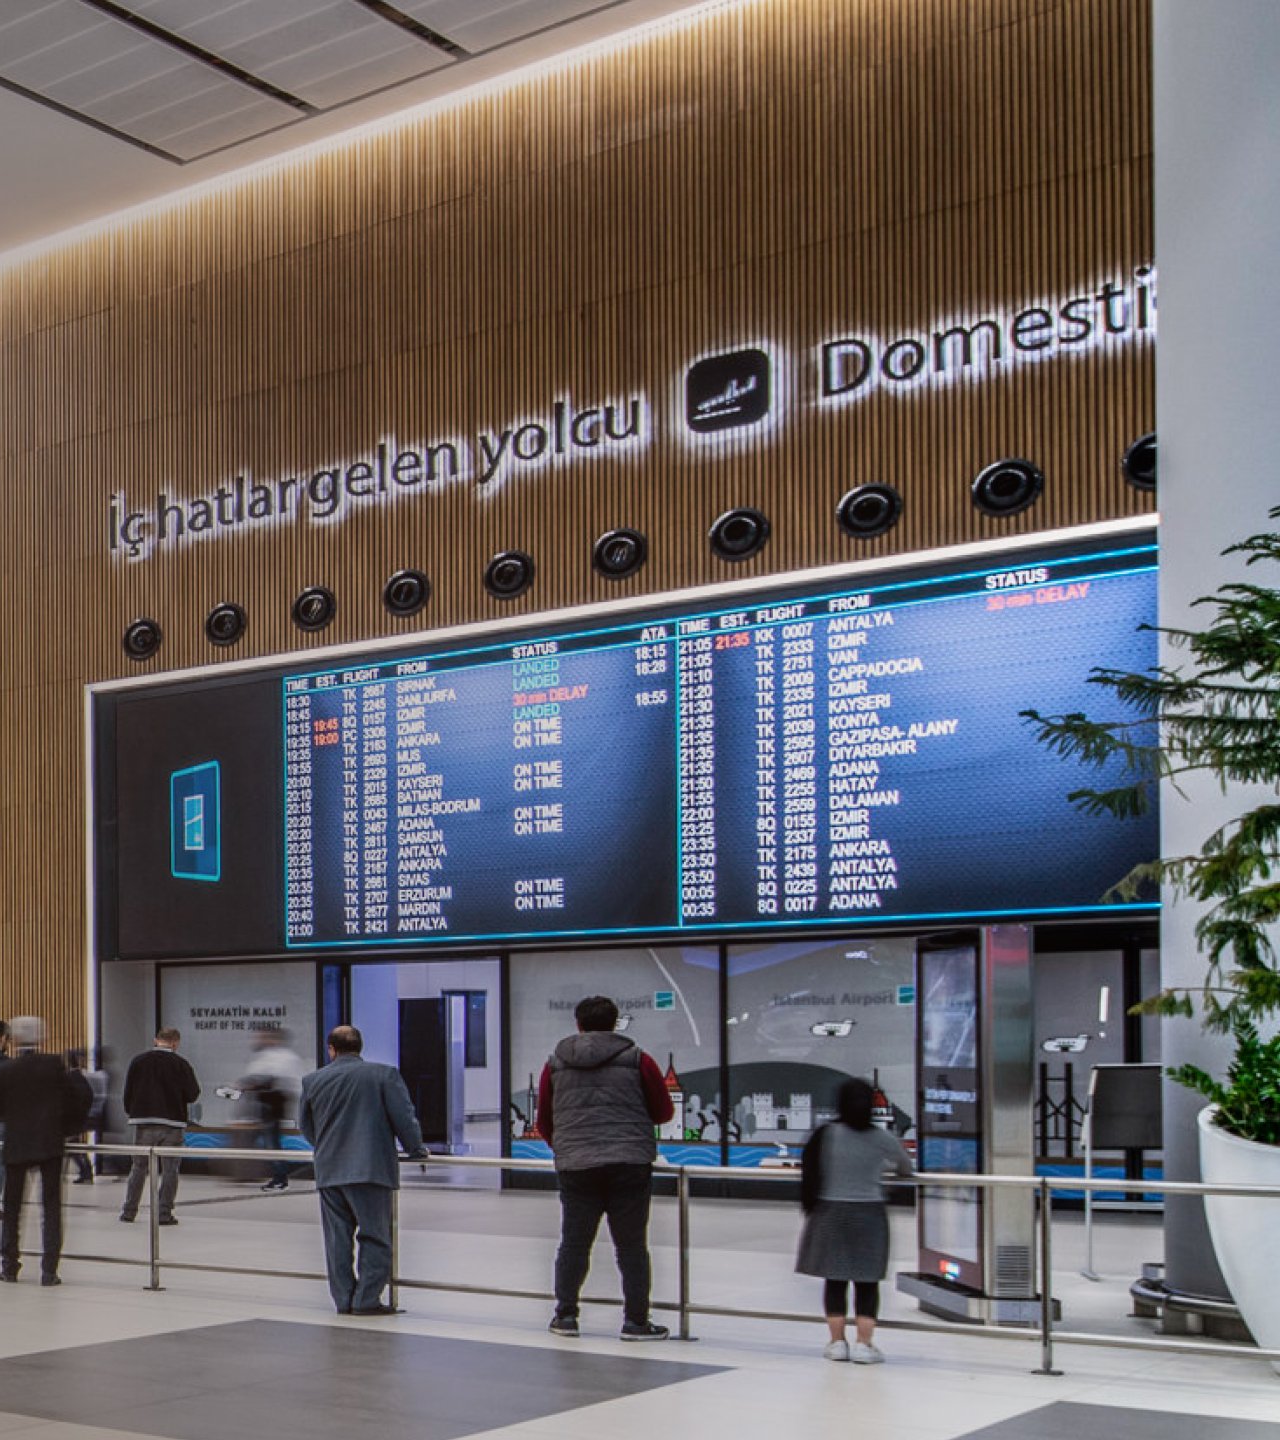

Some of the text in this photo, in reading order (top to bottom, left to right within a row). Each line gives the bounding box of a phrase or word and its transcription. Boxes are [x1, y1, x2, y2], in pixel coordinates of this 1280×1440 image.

[821, 267, 1155, 397] Domesti
[108, 400, 639, 556] İç hatlar gelen yolcu
[680, 566, 1048, 635] TIME EST. FLIGHT FROM STATUS
[679, 581, 1089, 655] 21:05 21:35 KK 0007 ANTALYA DELAY
[286, 625, 666, 692] TIME EST. FLIGHT FROM STATUS ATA
[679, 630, 867, 670] 21:05 TK IZMIR
[679, 648, 858, 685] 21:10 TK 2751 VAN
[342, 643, 666, 700] TK SIRNAK LANDED 18:15
[679, 683, 712, 701] 21:20
[755, 674, 775, 691] TK
[828, 656, 923, 682] CAPPADOCIA
[313, 683, 588, 732] 19:45 IZMIR DELAY
[342, 701, 357, 714] TK
[513, 672, 559, 691] LANDED
[680, 678, 867, 715] 21:30 TK IZMIR
[342, 689, 667, 742] PC IZMIR LANDED 18:55
[680, 692, 891, 731] 21:35 TK 2021 KAYSERI
[680, 710, 879, 746] 21:35 TK KONYA
[342, 716, 561, 755] TK ANKARA ON TIME
[342, 730, 561, 769] TK ON TIME
[680, 738, 776, 762] 21:35 TK
[342, 761, 426, 782] TK IZMIR
[680, 738, 916, 776] 21:35 TK DIYARBAKIR
[342, 759, 562, 795] TK 2015 KAYSERI ON TIME
[343, 774, 562, 808] TK BATMAN ON TIME
[680, 758, 880, 792] 21:50 TK ADANA
[680, 775, 878, 807] 21:55 TK HATAY
[343, 798, 480, 822] KK 0043 MILAS-BODRUM
[343, 803, 562, 835] TK ADANA ON TIME
[681, 789, 899, 822] 22:00 TK DALAMAN
[784, 808, 869, 829] 0155 IZMIR
[343, 818, 562, 849] TK SAMSUN ON TIME
[756, 830, 776, 846] TK
[829, 824, 869, 841] IZMIR
[343, 857, 442, 875] TK ANKARA
[397, 843, 447, 858] ANTALYA
[681, 839, 890, 868] 23:50 TK 2175 ANKARA
[343, 872, 430, 890] TK SIVAS
[681, 868, 714, 885] 23:50
[757, 864, 777, 879] TK
[829, 856, 897, 875] ANTALYA
[681, 873, 897, 900] 00:05 ANTALYA
[343, 877, 563, 904] TK ERZURUM ON TIME
[343, 893, 563, 919] TK MARDIN ON TIME
[681, 892, 880, 917] 00:35 0017 ADANA
[344, 920, 359, 934] TK
[397, 916, 447, 931] ANTALYA
[189, 1004, 287, 1018] SEYAHATİN KALBİ
[841, 991, 895, 1007] Airport
[195, 1020, 218, 1031] HEART
[220, 1020, 230, 1031] OF
[231, 1020, 245, 1031] THE
